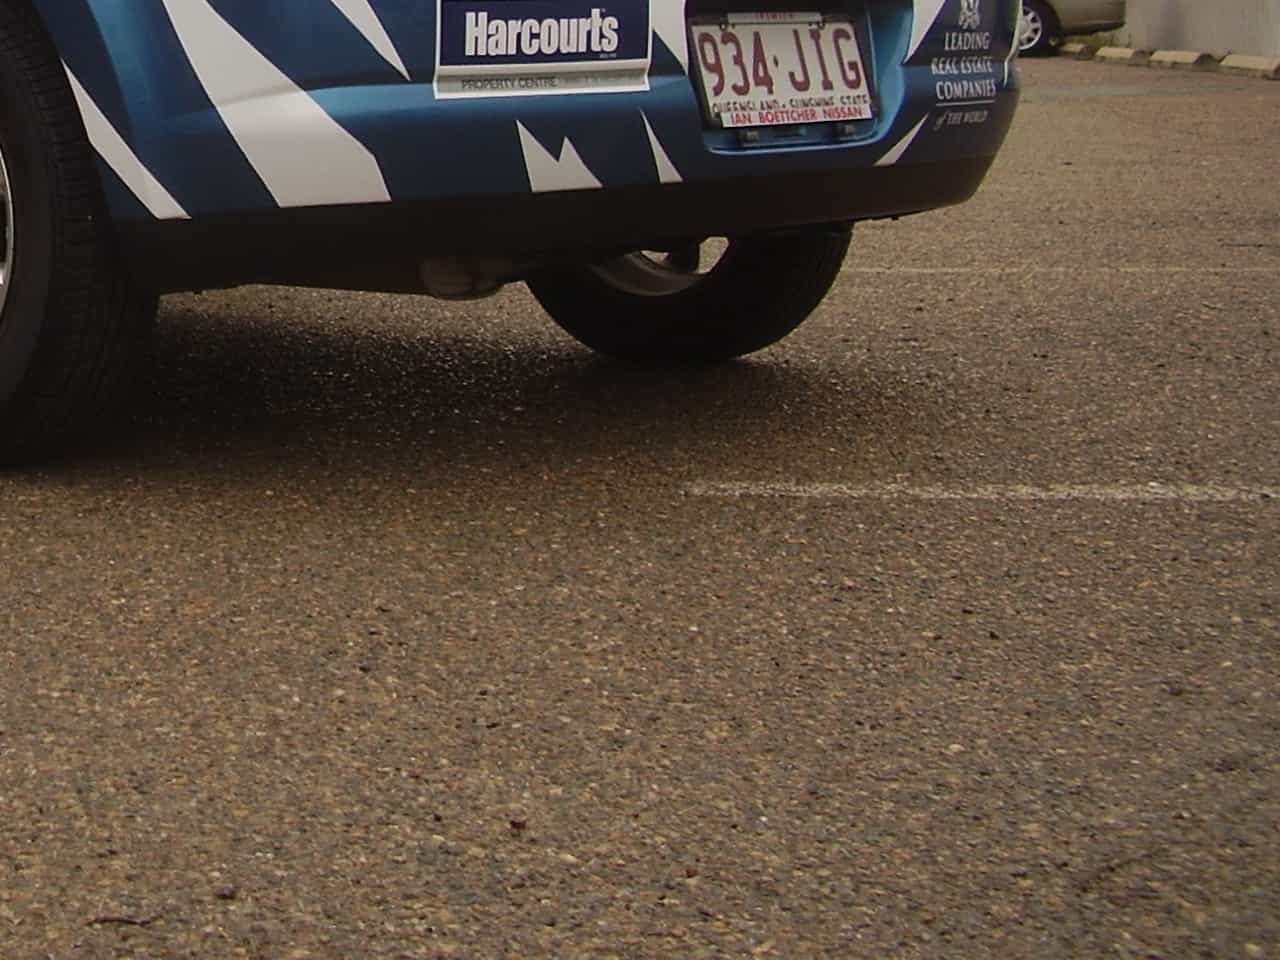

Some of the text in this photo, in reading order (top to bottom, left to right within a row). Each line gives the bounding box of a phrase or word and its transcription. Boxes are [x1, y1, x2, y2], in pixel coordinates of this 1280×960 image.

[464, 8, 619, 56] Harcourts
[944, 31, 991, 51] LEADING
[931, 56, 993, 75] REAL ESTATE
[461, 78, 515, 89] PROPERTY
[518, 76, 559, 88] CENTRE
[936, 79, 997, 100] COMPANIES
[840, 94, 868, 105] STATE
[731, 106, 863, 125] IAN BOETTCHER NISSAN
